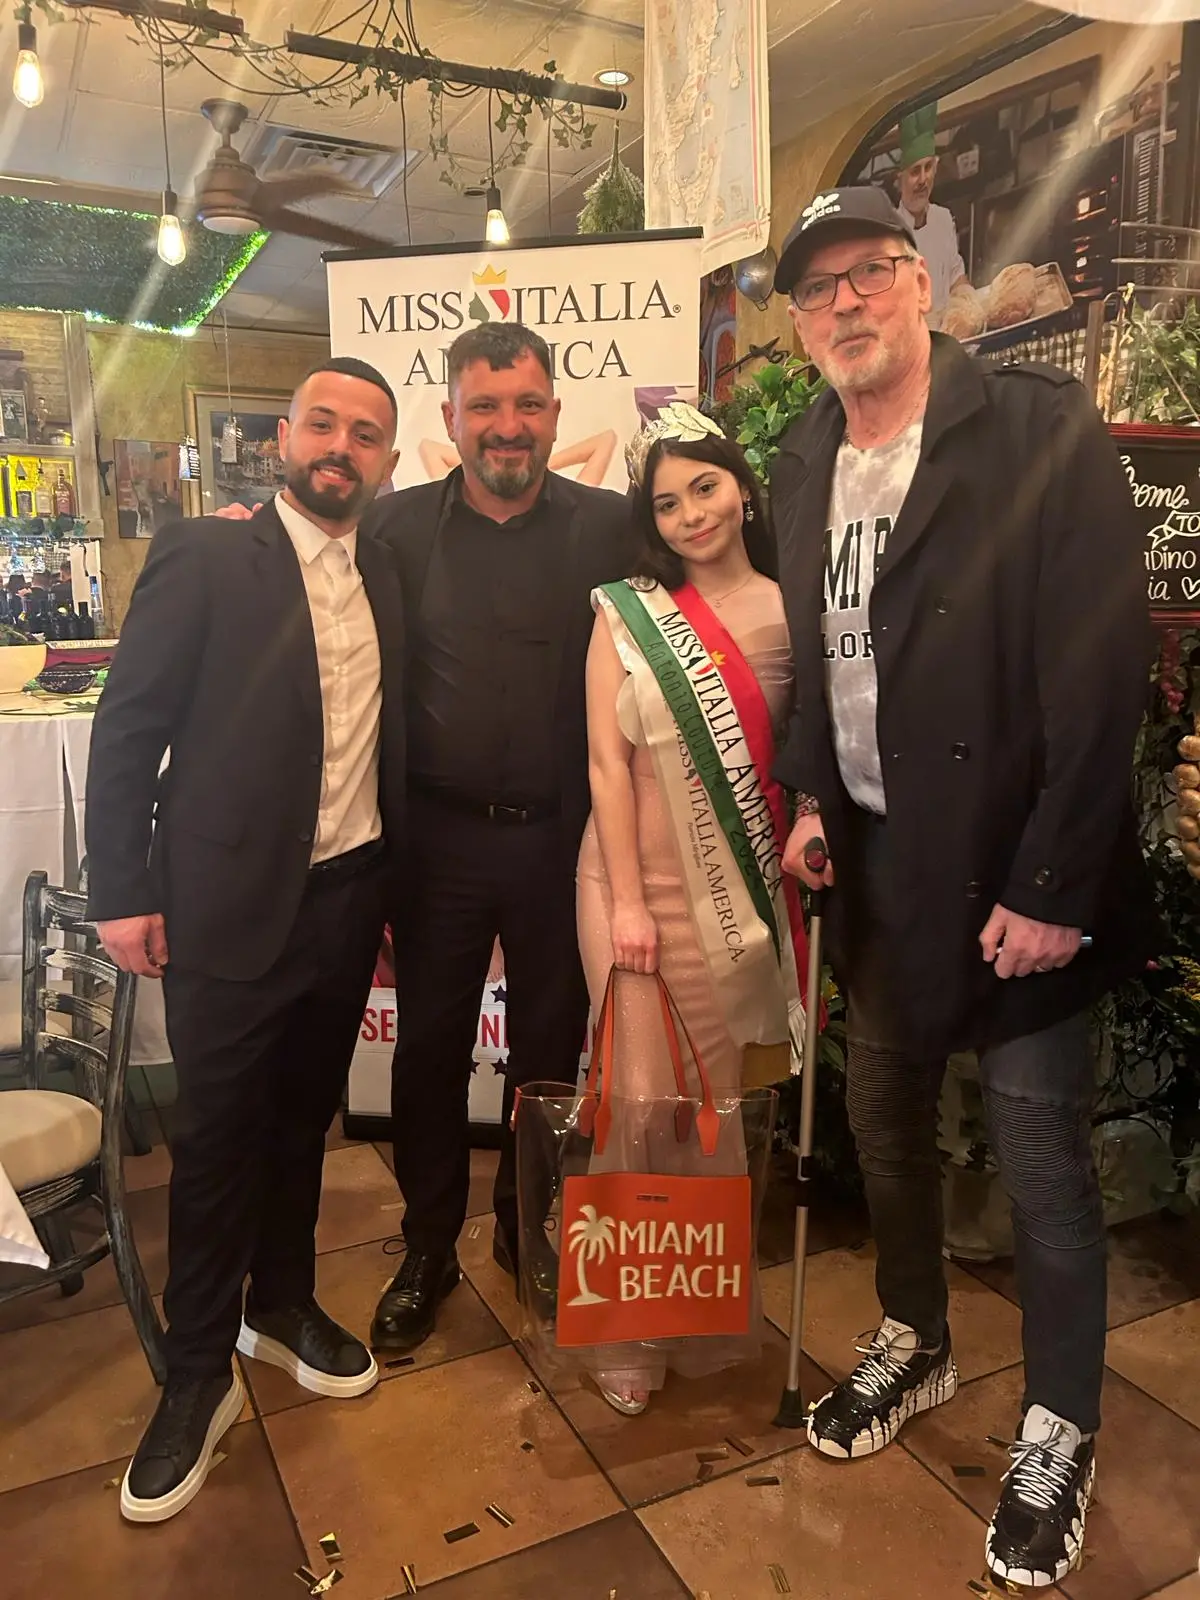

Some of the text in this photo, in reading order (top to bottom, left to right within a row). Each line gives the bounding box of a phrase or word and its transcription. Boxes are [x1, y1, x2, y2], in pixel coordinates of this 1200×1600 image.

[801, 204, 841, 231] adidas
[357, 291, 464, 335] MISS
[403, 339, 632, 386] AICA
[656, 610, 785, 902] MISS ITALIA AMERICA
[688, 787, 718, 859] ITALIA
[704, 861, 748, 962] AMERICA
[619, 1220, 724, 1256] MIAMI
[619, 1264, 741, 1301] BEACH
